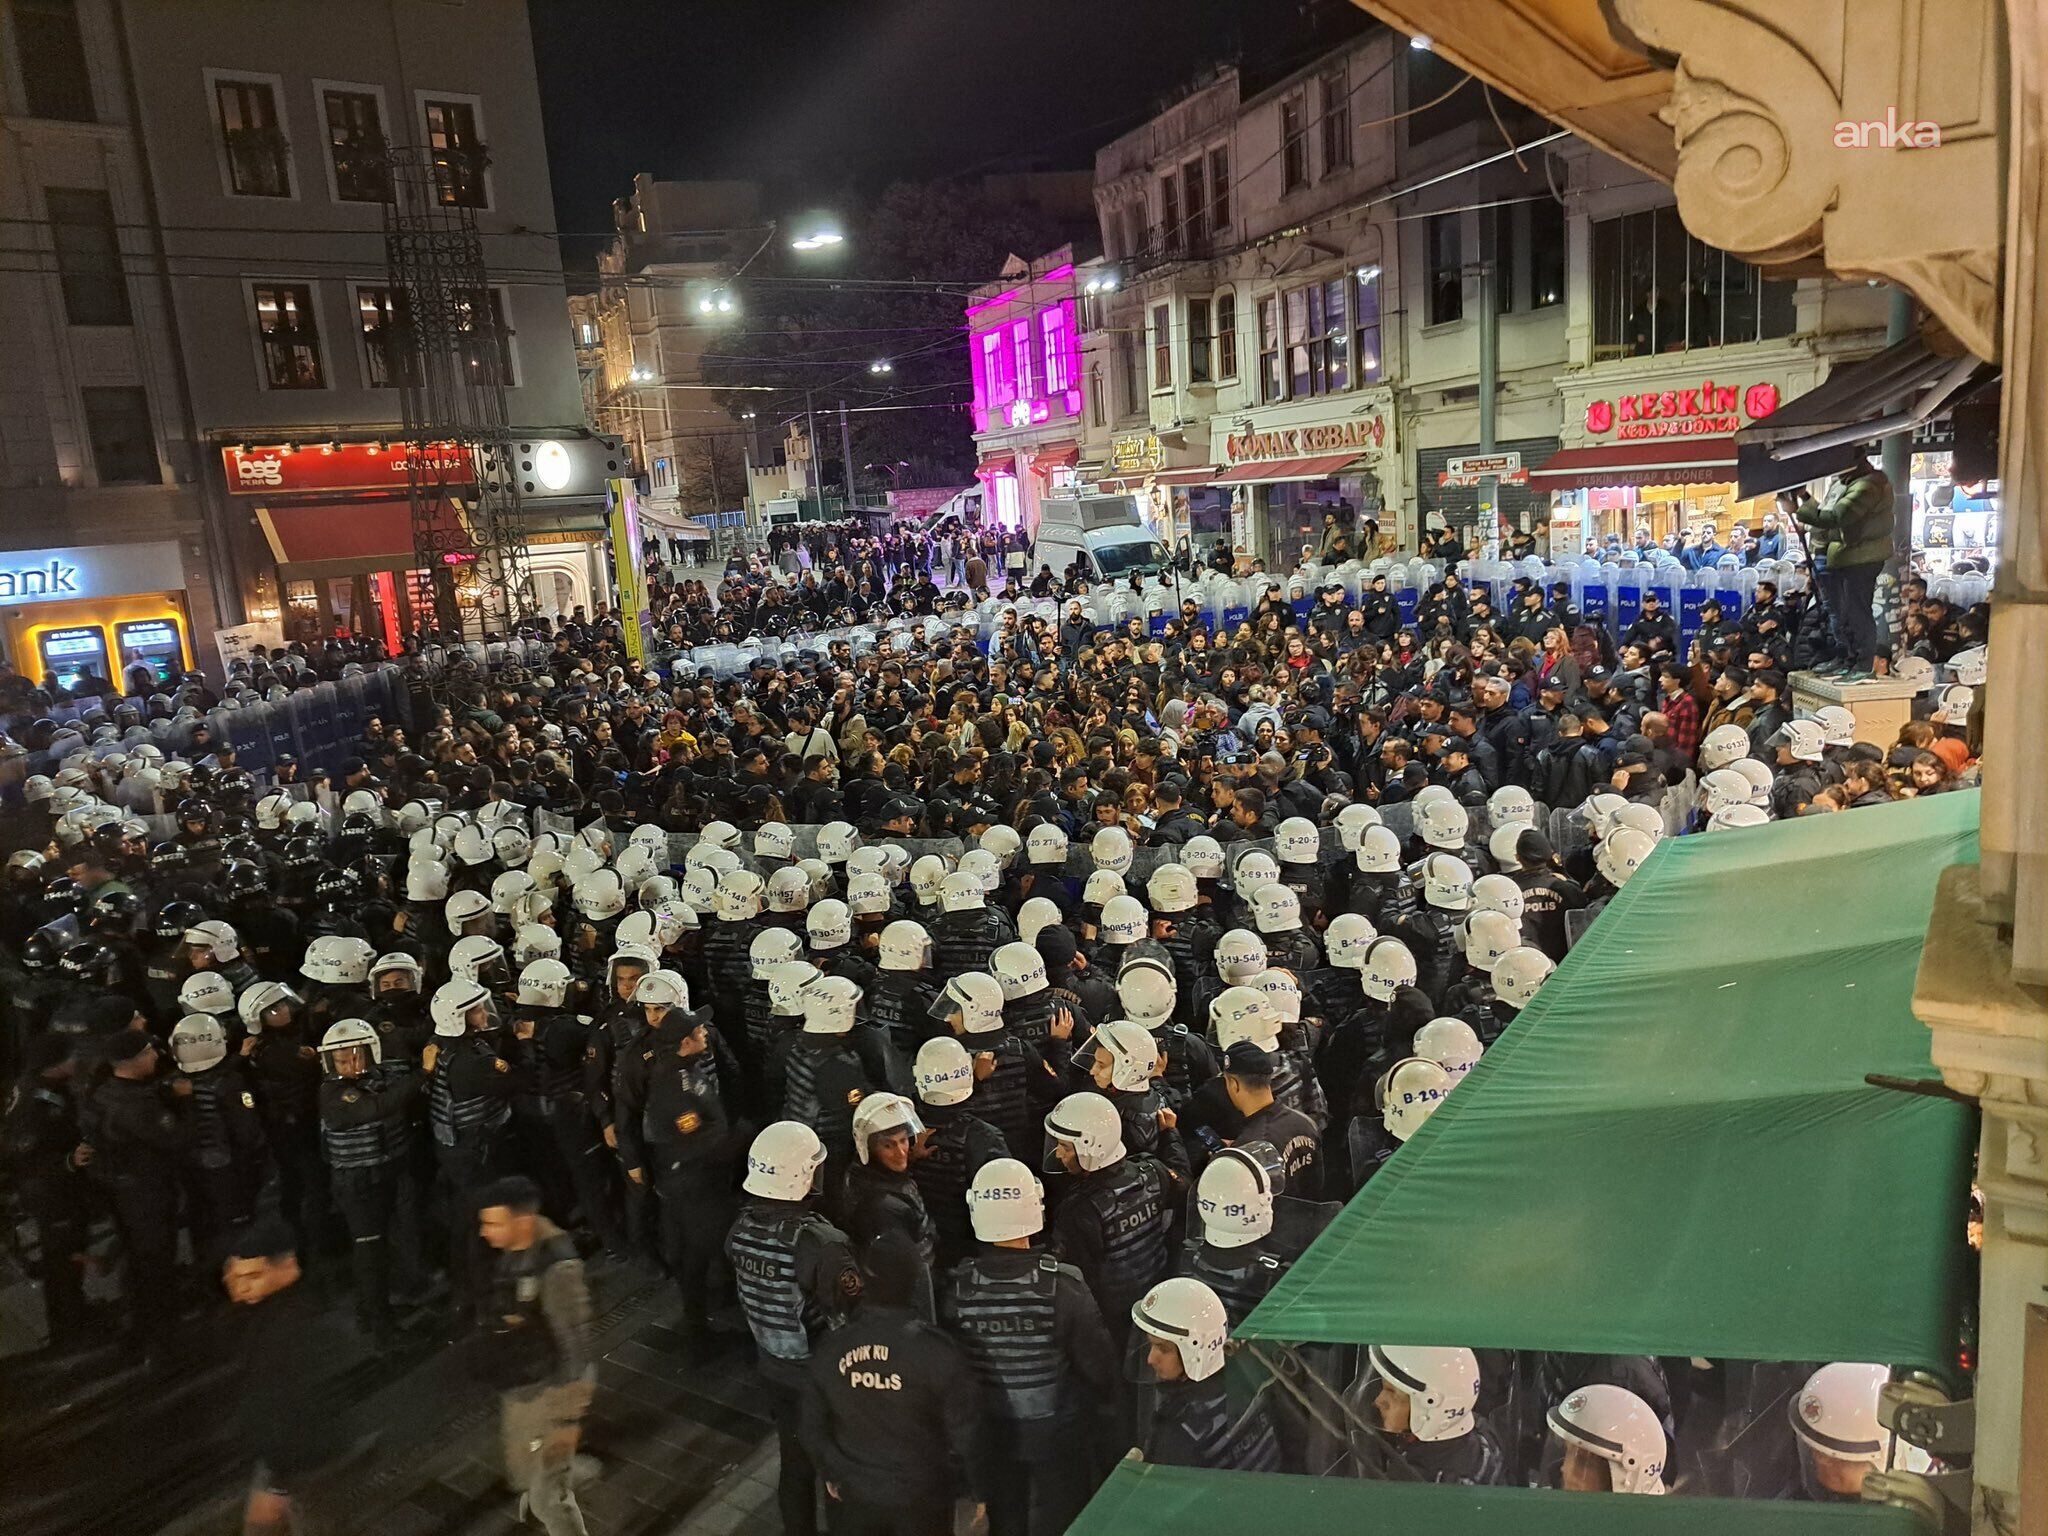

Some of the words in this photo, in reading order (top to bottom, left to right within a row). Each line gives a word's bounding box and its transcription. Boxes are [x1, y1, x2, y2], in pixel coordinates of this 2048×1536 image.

[1618, 380, 1739, 422] KESKİN
[1233, 429, 1299, 459] KONAK
[1301, 421, 1373, 451] KEBAP
[1119, 1203, 1159, 1232] POLİS
[1222, 1204, 1247, 1217] 191
[976, 1316, 1035, 1334] POLİS
[1447, 1406, 1465, 1419] 34
[1648, 1461, 1662, 1477] 34
